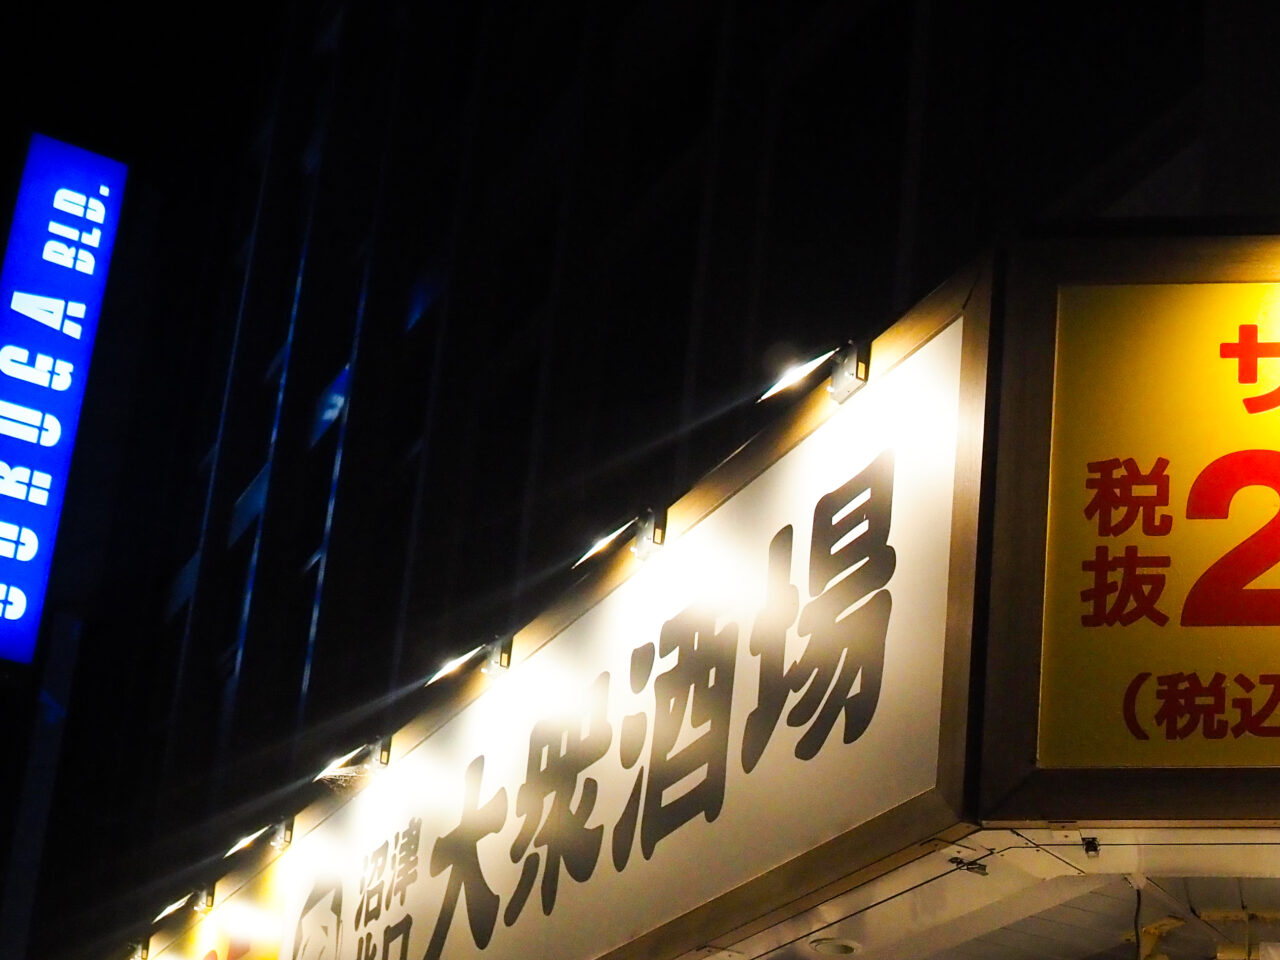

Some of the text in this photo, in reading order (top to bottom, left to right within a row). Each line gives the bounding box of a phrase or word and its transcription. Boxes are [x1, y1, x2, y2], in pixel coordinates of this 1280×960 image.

[42, 184, 111, 275] BLD.
[1081, 457, 1173, 629] 税抜
[355, 817, 422, 932] 沼津
